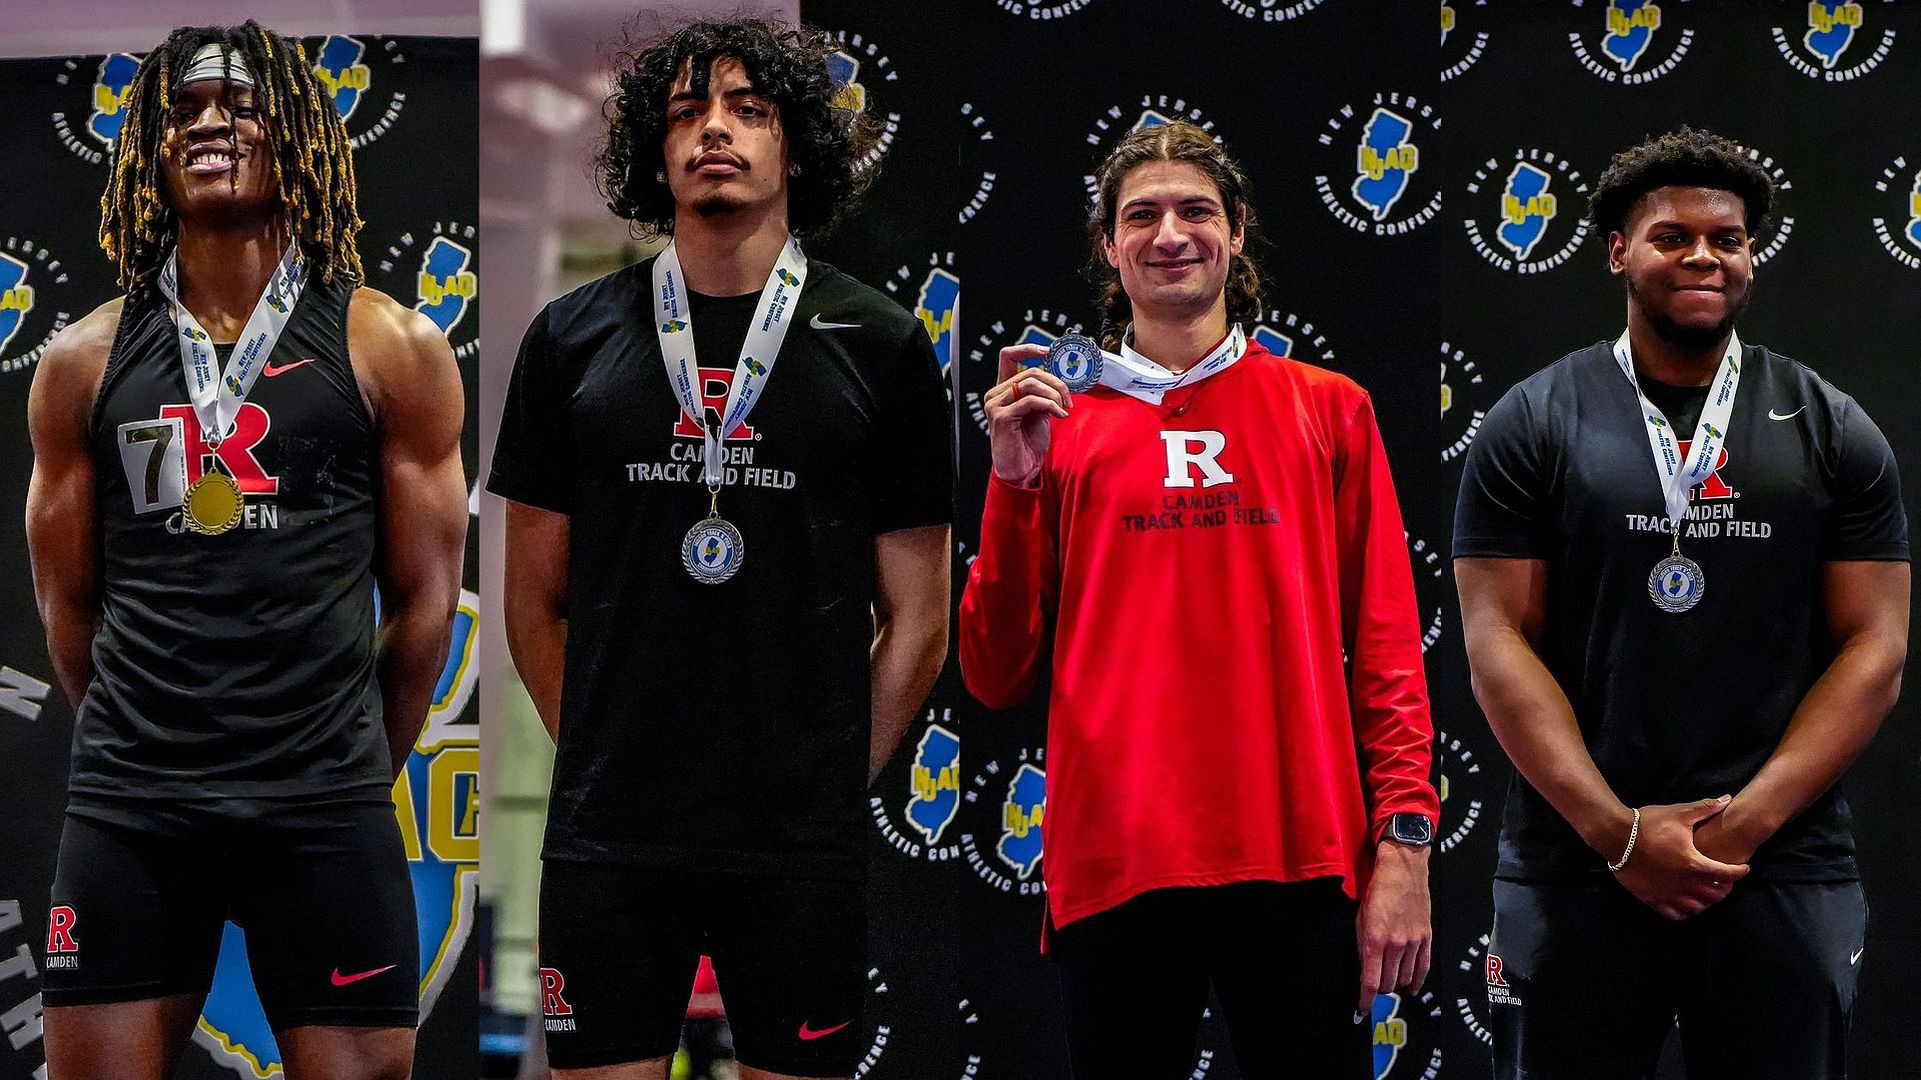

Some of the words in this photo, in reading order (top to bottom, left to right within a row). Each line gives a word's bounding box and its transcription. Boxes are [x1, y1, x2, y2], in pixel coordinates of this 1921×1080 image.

[1568, 32, 1617, 82] ATHLETIC
[1771, 27, 1819, 79] ATHLETIC
[1086, 105, 1122, 145] NEW
[1318, 104, 1354, 145] NEW
[1467, 158, 1498, 193] NEW
[1515, 148, 1588, 192] JERSEY
[1315, 175, 1368, 233] ATHLETIC
[7, 236, 69, 284] ERSEY
[1464, 219, 1513, 271] ATHLETIC
[1873, 217, 1920, 269] ATHLETIC
[971, 321, 1005, 361] NEW
[673, 367, 754, 441] R
[125, 424, 173, 505] 7
[159, 402, 279, 496] R
[1160, 429, 1234, 488] R
[626, 463, 690, 483] TRACK
[744, 467, 796, 490] FIELD
[1123, 511, 1184, 532] TRACK
[1192, 511, 1227, 529] AND
[1235, 508, 1281, 525] FIELD
[1163, 491, 1239, 511] CAMDEN
[1686, 523, 1720, 538] AND
[1726, 521, 1772, 539] FIELD
[965, 760, 999, 802] NEW
[870, 797, 920, 857] ATHLETIC
[961, 833, 1012, 892] ATHLETIC
[47, 906, 78, 953] R
[46, 956, 78, 968] CAMDEN
[1487, 954, 1507, 986] R
[540, 967, 573, 1016] R
